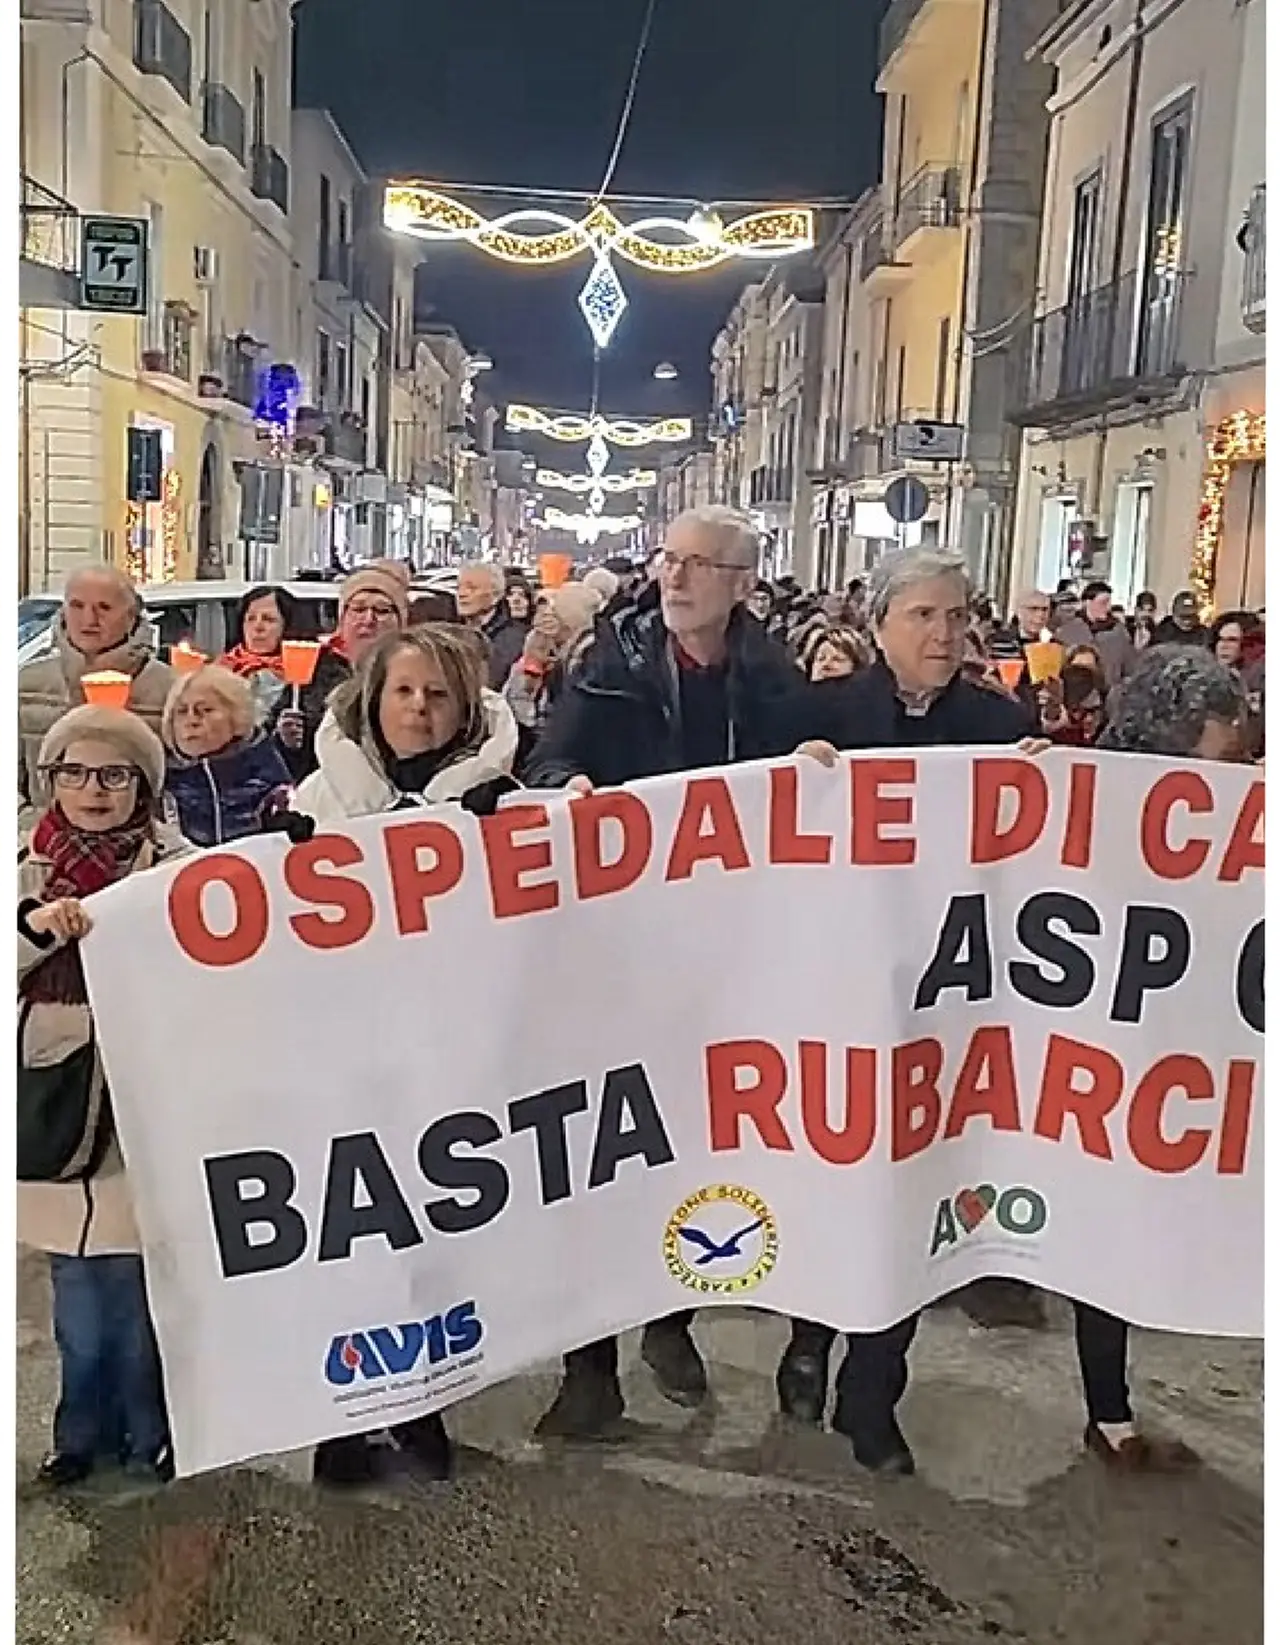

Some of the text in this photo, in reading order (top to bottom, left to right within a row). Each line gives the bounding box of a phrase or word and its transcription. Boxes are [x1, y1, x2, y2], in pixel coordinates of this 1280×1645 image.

[168, 757, 918, 967] OSPEDALE
[970, 757, 1098, 869] DI
[914, 890, 1191, 1024] ASP
[204, 1024, 1257, 1278] BASTA RUBARCI
[325, 1299, 484, 1386] AVIS
